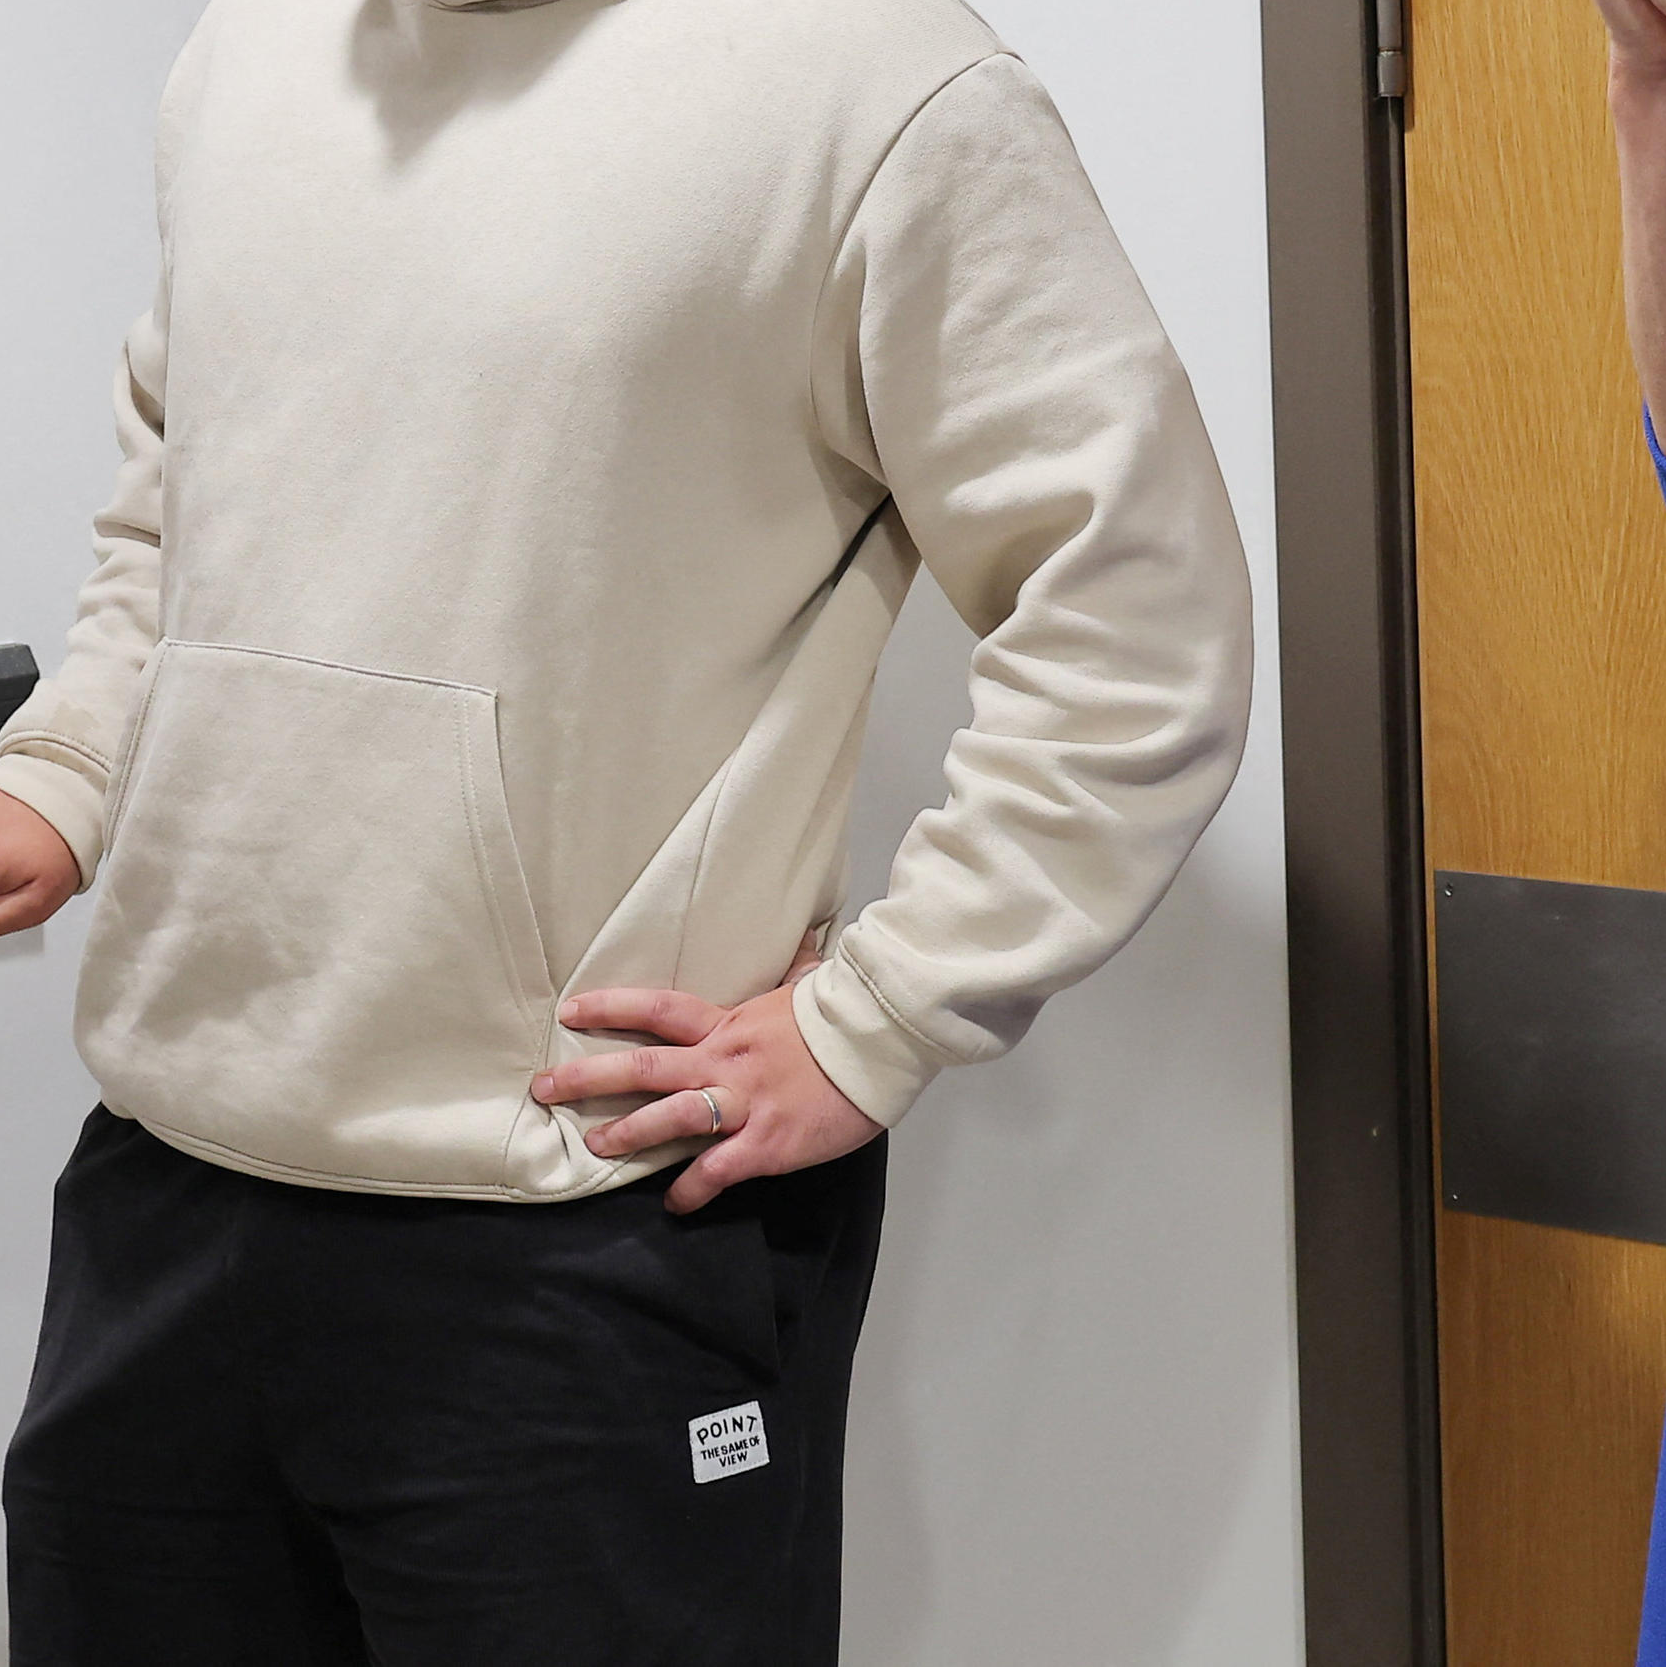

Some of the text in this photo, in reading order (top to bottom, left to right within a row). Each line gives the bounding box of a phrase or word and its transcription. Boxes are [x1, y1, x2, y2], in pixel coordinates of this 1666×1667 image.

[697, 1416, 757, 1445] POINT
[701, 1436, 760, 1460] THE SAME OF
[719, 1451, 748, 1467] VIEW
